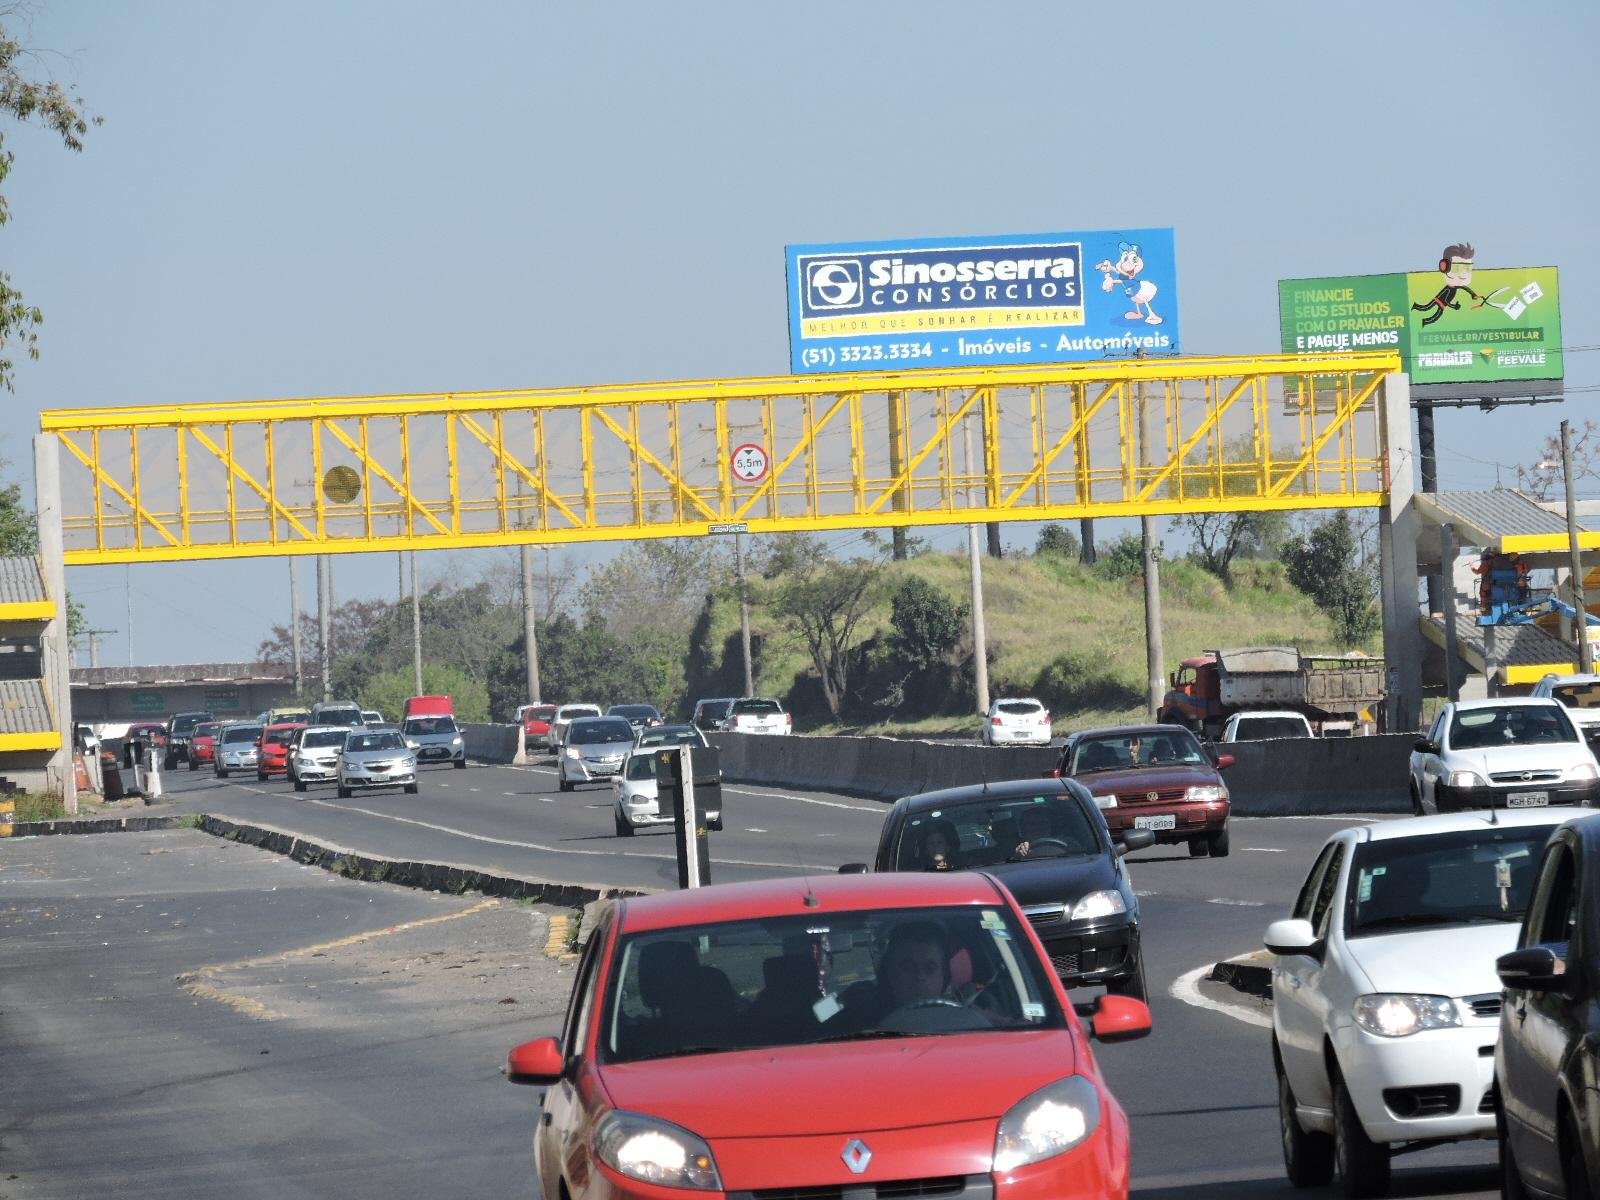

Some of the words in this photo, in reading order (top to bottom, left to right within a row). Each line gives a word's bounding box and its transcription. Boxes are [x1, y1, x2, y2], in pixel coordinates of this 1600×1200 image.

[869, 257, 1076, 288] Sinosserra
[871, 281, 1077, 306] CONSÓRCIOS
[1294, 288, 1354, 303] FINANCIE
[1294, 304, 1329, 318] SEUS
[1330, 301, 1391, 317] ESTUDOS
[809, 320, 868, 333] MELHOR
[879, 319, 906, 330] QUE
[918, 314, 977, 328] SONHAR
[1006, 310, 1080, 323] REALIZAR
[1296, 319, 1324, 334] COM
[1327, 319, 1337, 332] O
[1339, 315, 1406, 331] PRAVALER
[1297, 336, 1305, 349] E
[1307, 333, 1350, 349] PAGUE
[1352, 330, 1399, 347] MENOS
[802, 347, 836, 368] (51)
[840, 341, 933, 362] 3323.3334
[958, 336, 1032, 357] Imóveis
[1056, 331, 1170, 353] Automóveis
[1497, 353, 1547, 365] FEEVALE
[737, 458, 763, 470] 5,5m
